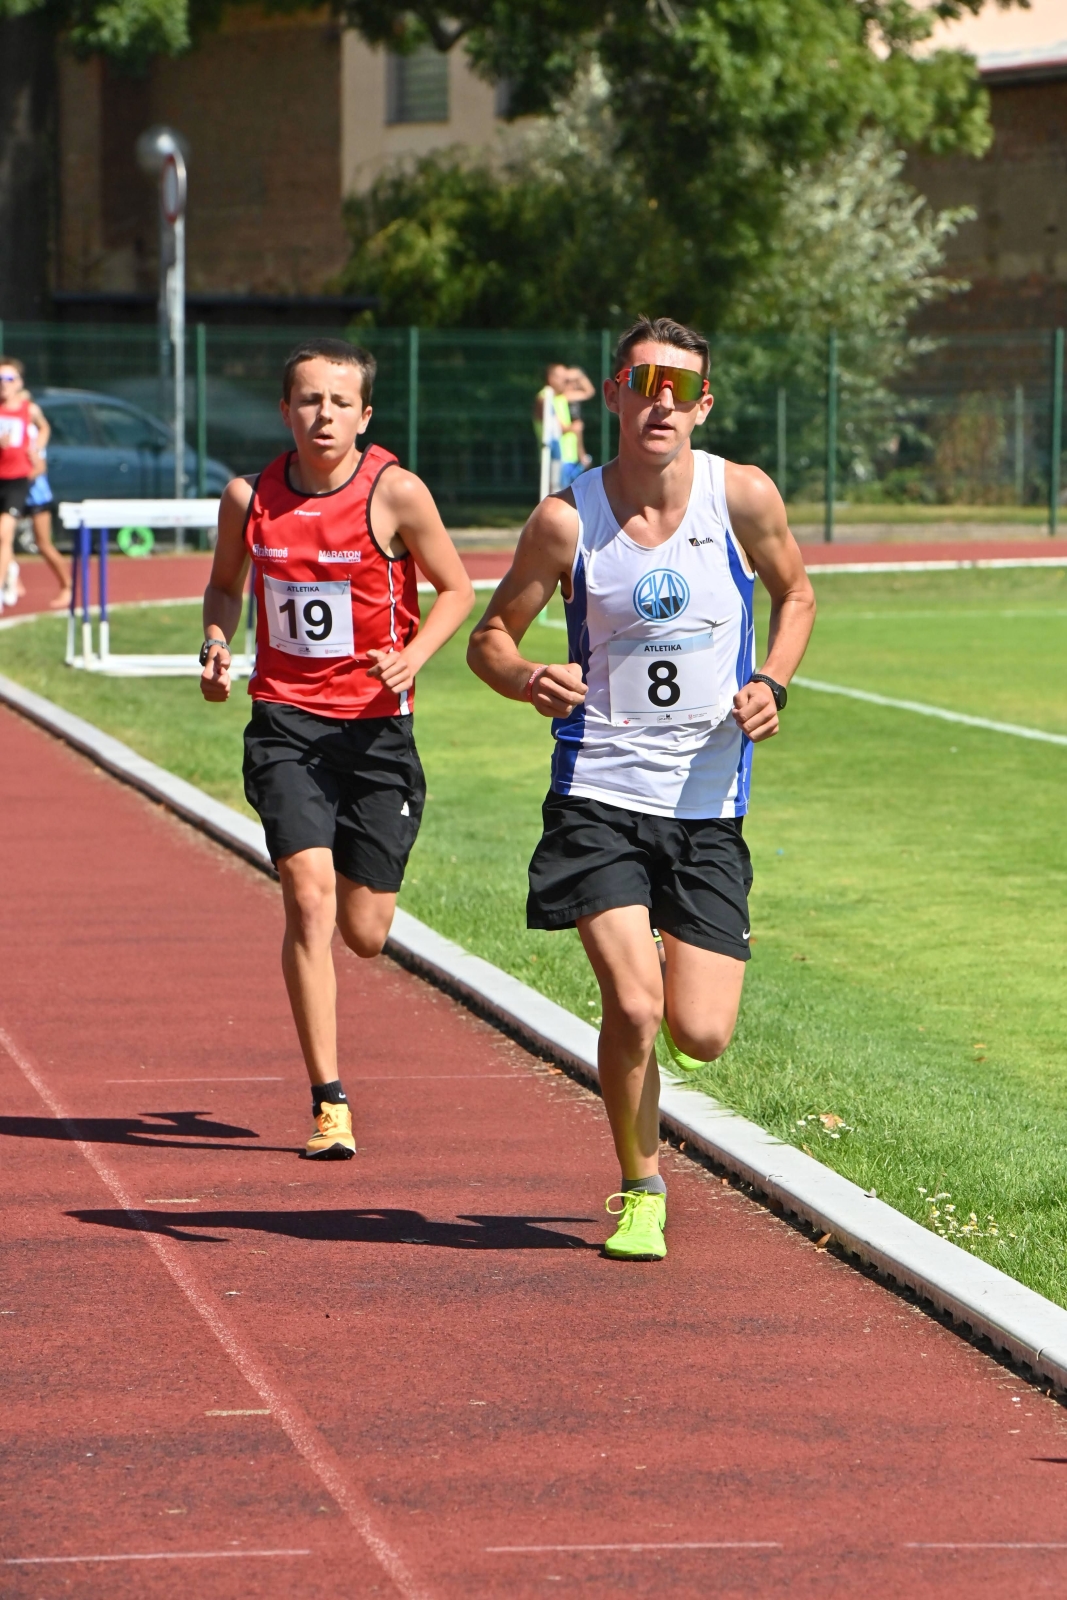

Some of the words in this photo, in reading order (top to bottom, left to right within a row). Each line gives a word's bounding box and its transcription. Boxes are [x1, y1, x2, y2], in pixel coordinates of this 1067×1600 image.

[319, 550, 362, 558] MARATON
[278, 598, 333, 641] 19
[643, 644, 682, 652] ATLETIKA
[647, 660, 681, 708] 8
